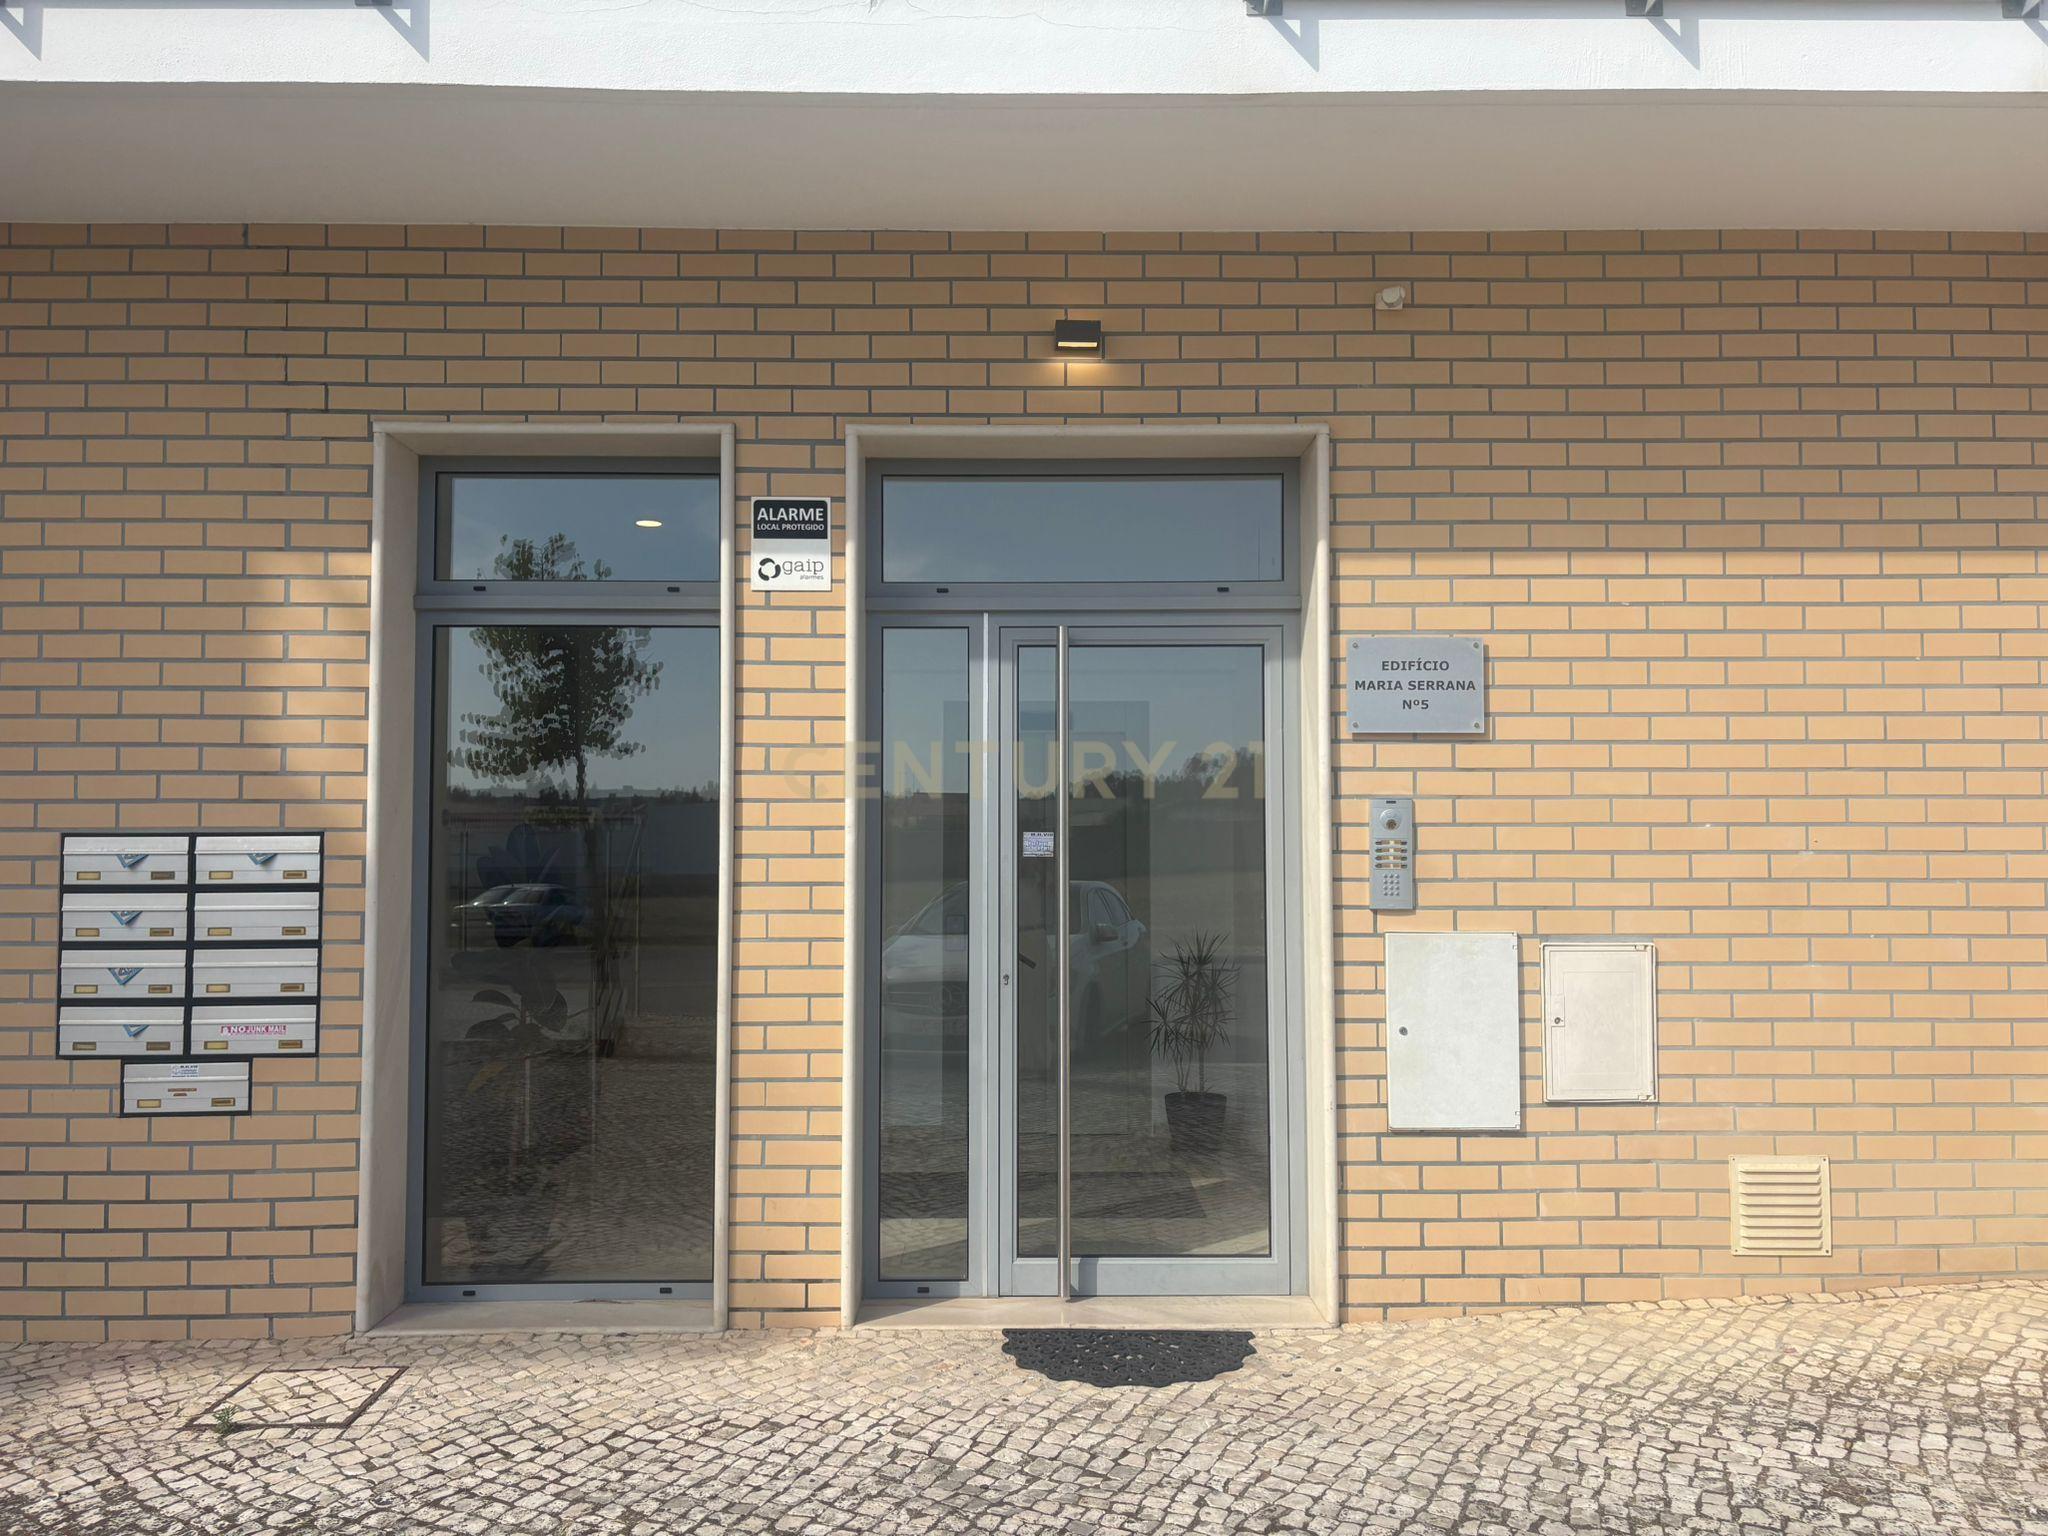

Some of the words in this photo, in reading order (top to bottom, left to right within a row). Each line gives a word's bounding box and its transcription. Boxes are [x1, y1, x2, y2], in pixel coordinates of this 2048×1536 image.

[757, 508, 824, 521] ALARME
[757, 523, 780, 531] LOCAL
[781, 523, 825, 531] PROTEGIDO
[782, 559, 824, 575] gaip
[1381, 658, 1450, 671] EDIFÍCIO
[1354, 680, 1403, 690] MARIA
[1407, 680, 1476, 690] SERRANA
[1402, 699, 1429, 710] Nº5
[231, 1025, 246, 1033] NO
[247, 1025, 267, 1033] JUNK
[268, 1025, 285, 1033] MAIL
